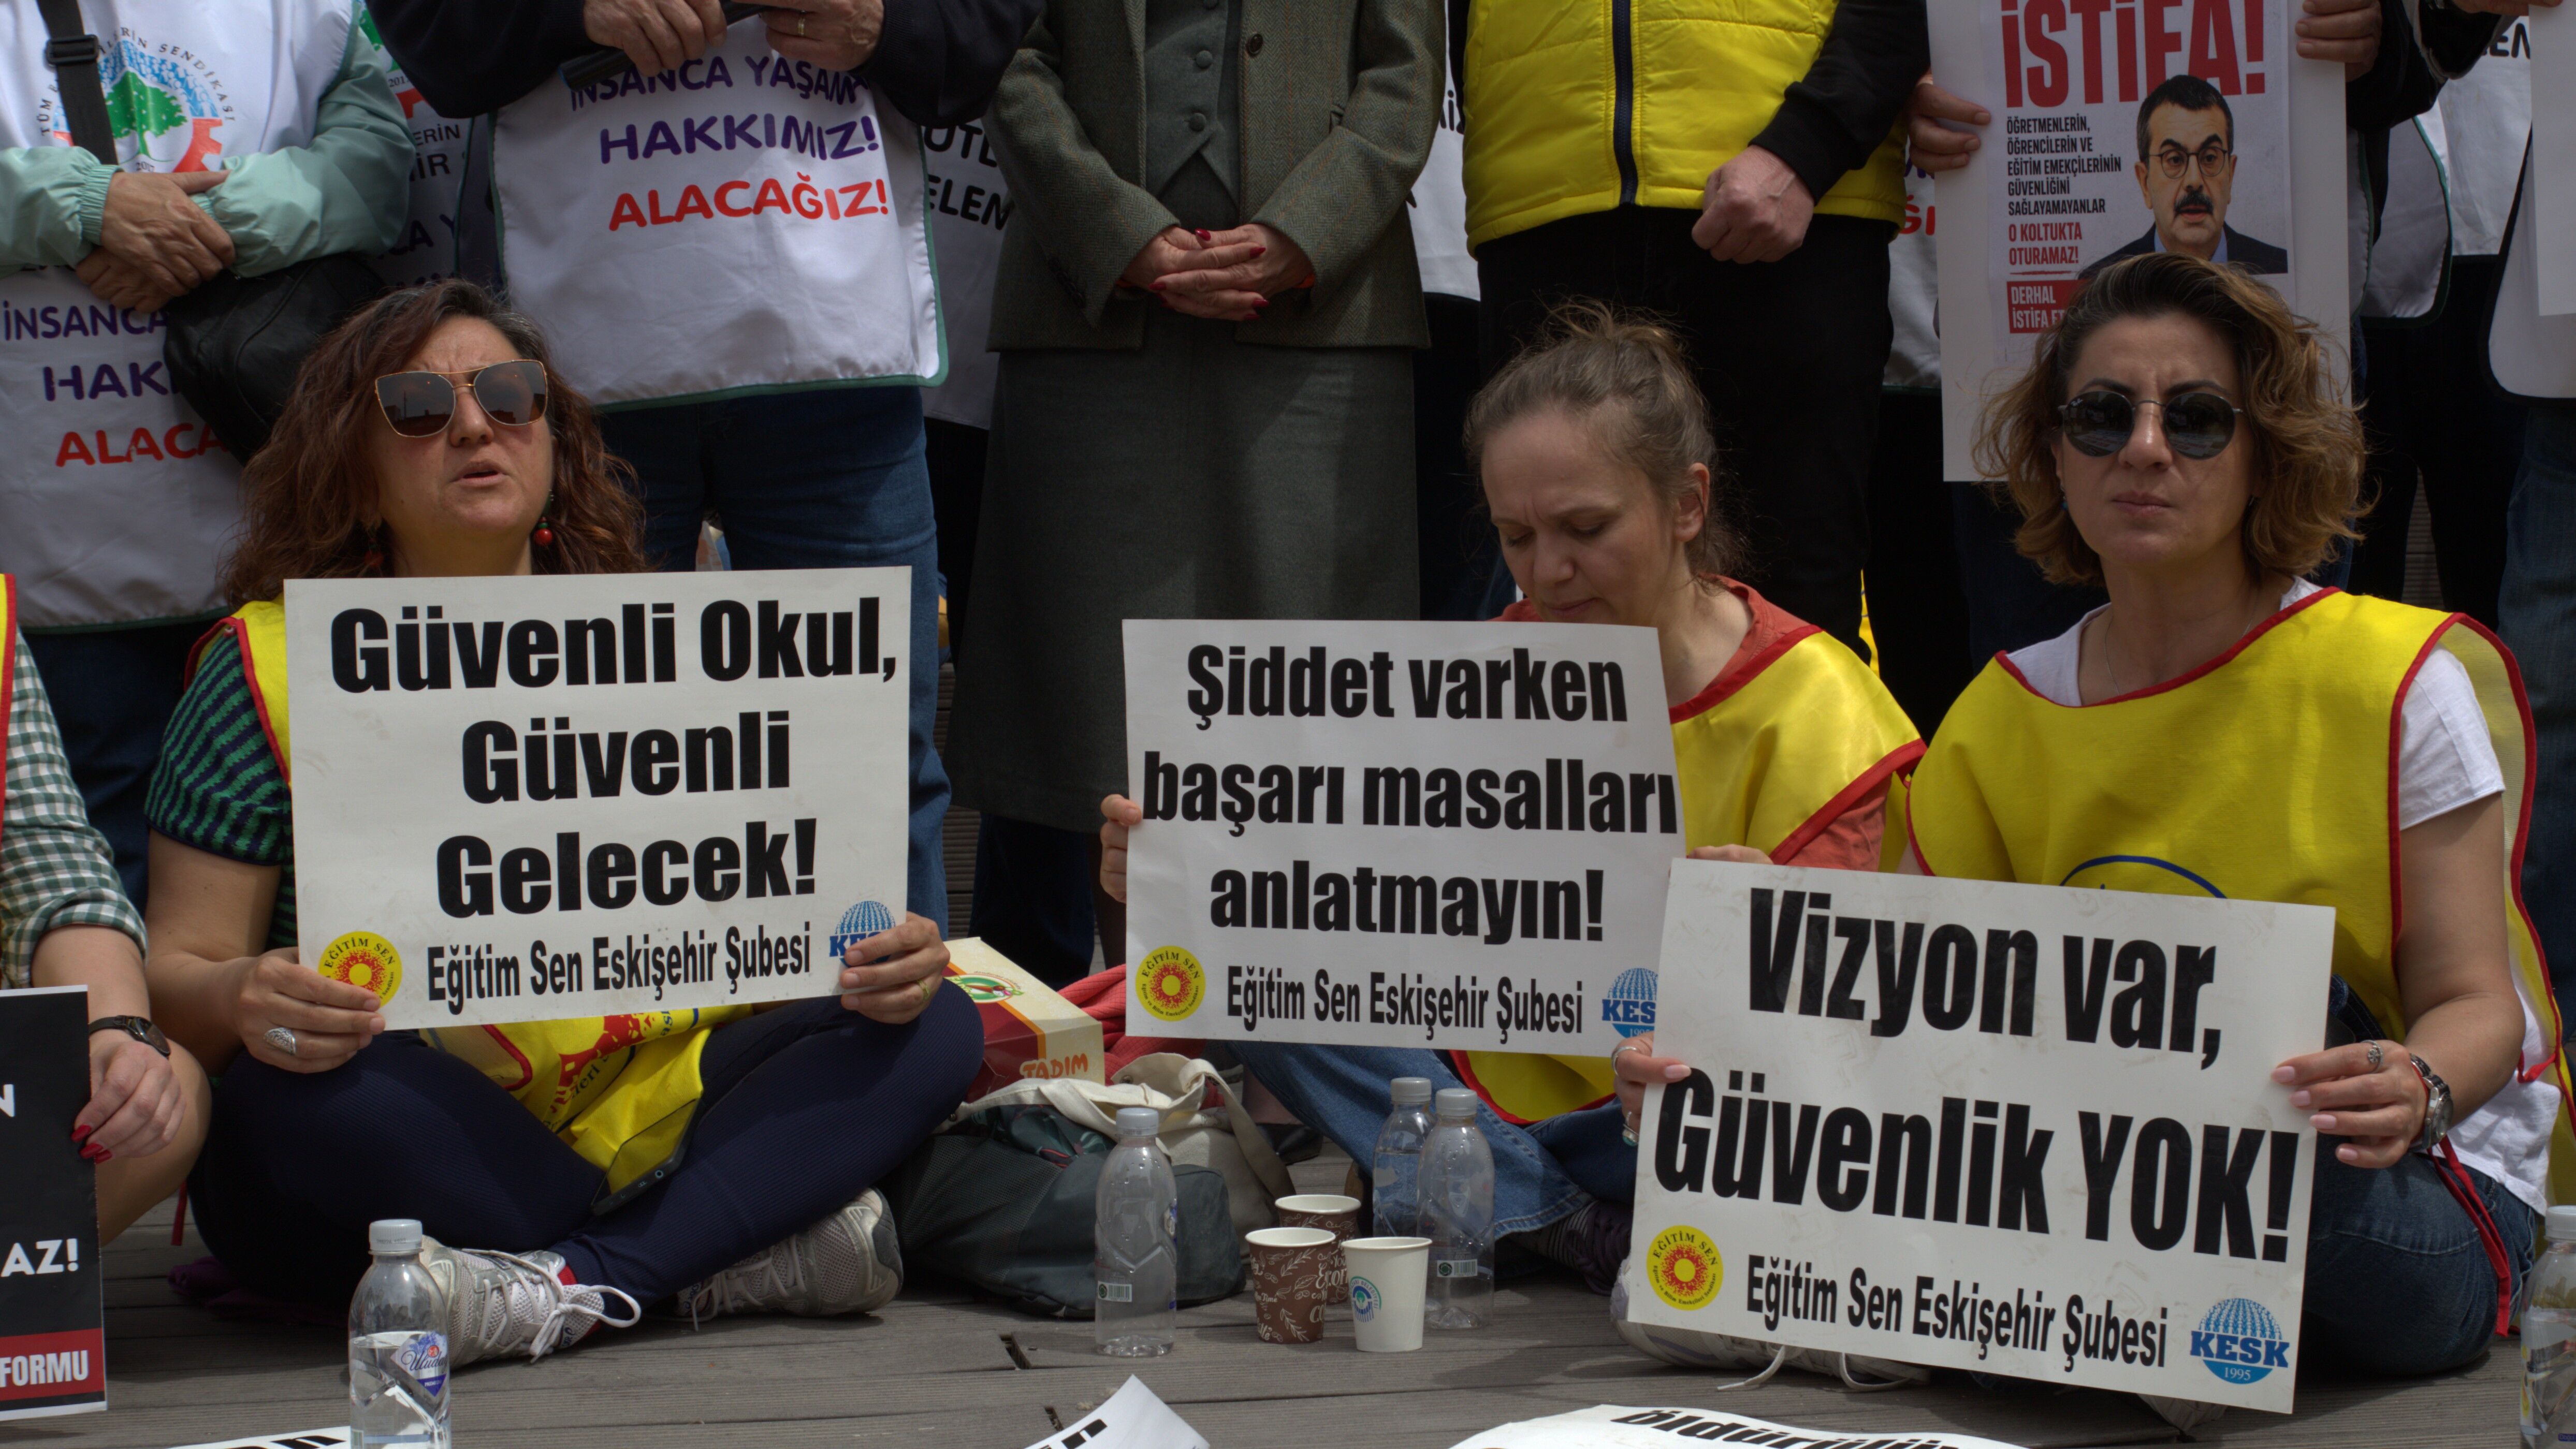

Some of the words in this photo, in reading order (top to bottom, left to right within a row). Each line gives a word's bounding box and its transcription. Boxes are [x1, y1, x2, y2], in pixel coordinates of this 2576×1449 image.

[2001, 0, 2266, 108] İSTİFA!
[600, 113, 879, 164] HAKKIMIZ!
[2006, 115, 2091, 135] ÖĞRETMENLERİN,
[2007, 137, 2077, 155] ÖĞRENCİLERİN
[2081, 137, 2093, 152] VE
[2007, 158, 2042, 177] EĞİTİM
[2044, 154, 2121, 176] EMEKÇİLERİNİN
[610, 172, 888, 230] ALACAĞIZ!
[2008, 177, 2070, 197] GÜVENLİĞİNİ
[2009, 198, 2106, 216] SAĞLAYAMAYANLAR
[2009, 225, 2017, 242] O
[2020, 222, 2082, 241] KOLTUKTA
[2009, 246, 2079, 265] OTURAMAZ!
[2011, 286, 2056, 304] DERHAL
[2012, 306, 2049, 328] İSTİFA
[331, 603, 676, 693] Güvenli
[701, 597, 895, 682] Okul,
[1188, 645, 1394, 730] Şiddet
[1408, 648, 1627, 722] varken
[462, 711, 789, 803] Güvenli
[1142, 751, 1344, 837] başarı
[1363, 758, 1677, 833] masalları
[437, 818, 816, 918] Gelecek!
[1211, 860, 1603, 945] anlatmayın!
[324, 937, 369, 968] EĞİTİM
[374, 943, 395, 965] SEN
[428, 944, 520, 1015] Eğitim
[531, 941, 582, 995] Sen
[593, 930, 717, 1001] Eskişehir
[726, 921, 809, 994] Şubesi
[1141, 950, 1180, 978] EĞİTİM
[1183, 958, 1200, 979] SEN
[1750, 888, 2037, 1037] Vizyon
[2063, 935, 2220, 1070] var,
[1228, 966, 1304, 1031] Eğitim
[1314, 969, 1360, 1022] Sen
[1370, 972, 1489, 1041] Eskişehir
[1497, 977, 1582, 1044] Şubesi
[1023, 1053, 1088, 1079] TADIM
[1655, 1067, 2055, 1235] Güvenlik
[2078, 1111, 2299, 1262] YOK!
[2, 1237, 79, 1278] AZ!
[1653, 1231, 1695, 1258] EĞİTİM
[1699, 1241, 1718, 1265] SEN
[1748, 1255, 1837, 1331] Eğitim
[1848, 1267, 1902, 1331] Sen
[1913, 1276, 2056, 1360] Eskişehir
[2063, 1295, 2167, 1372] Şubesi
[0, 1349, 89, 1388] FORMU
[2190, 1330, 2290, 1368] KESK
[2224, 1367, 2252, 1382] 1995
